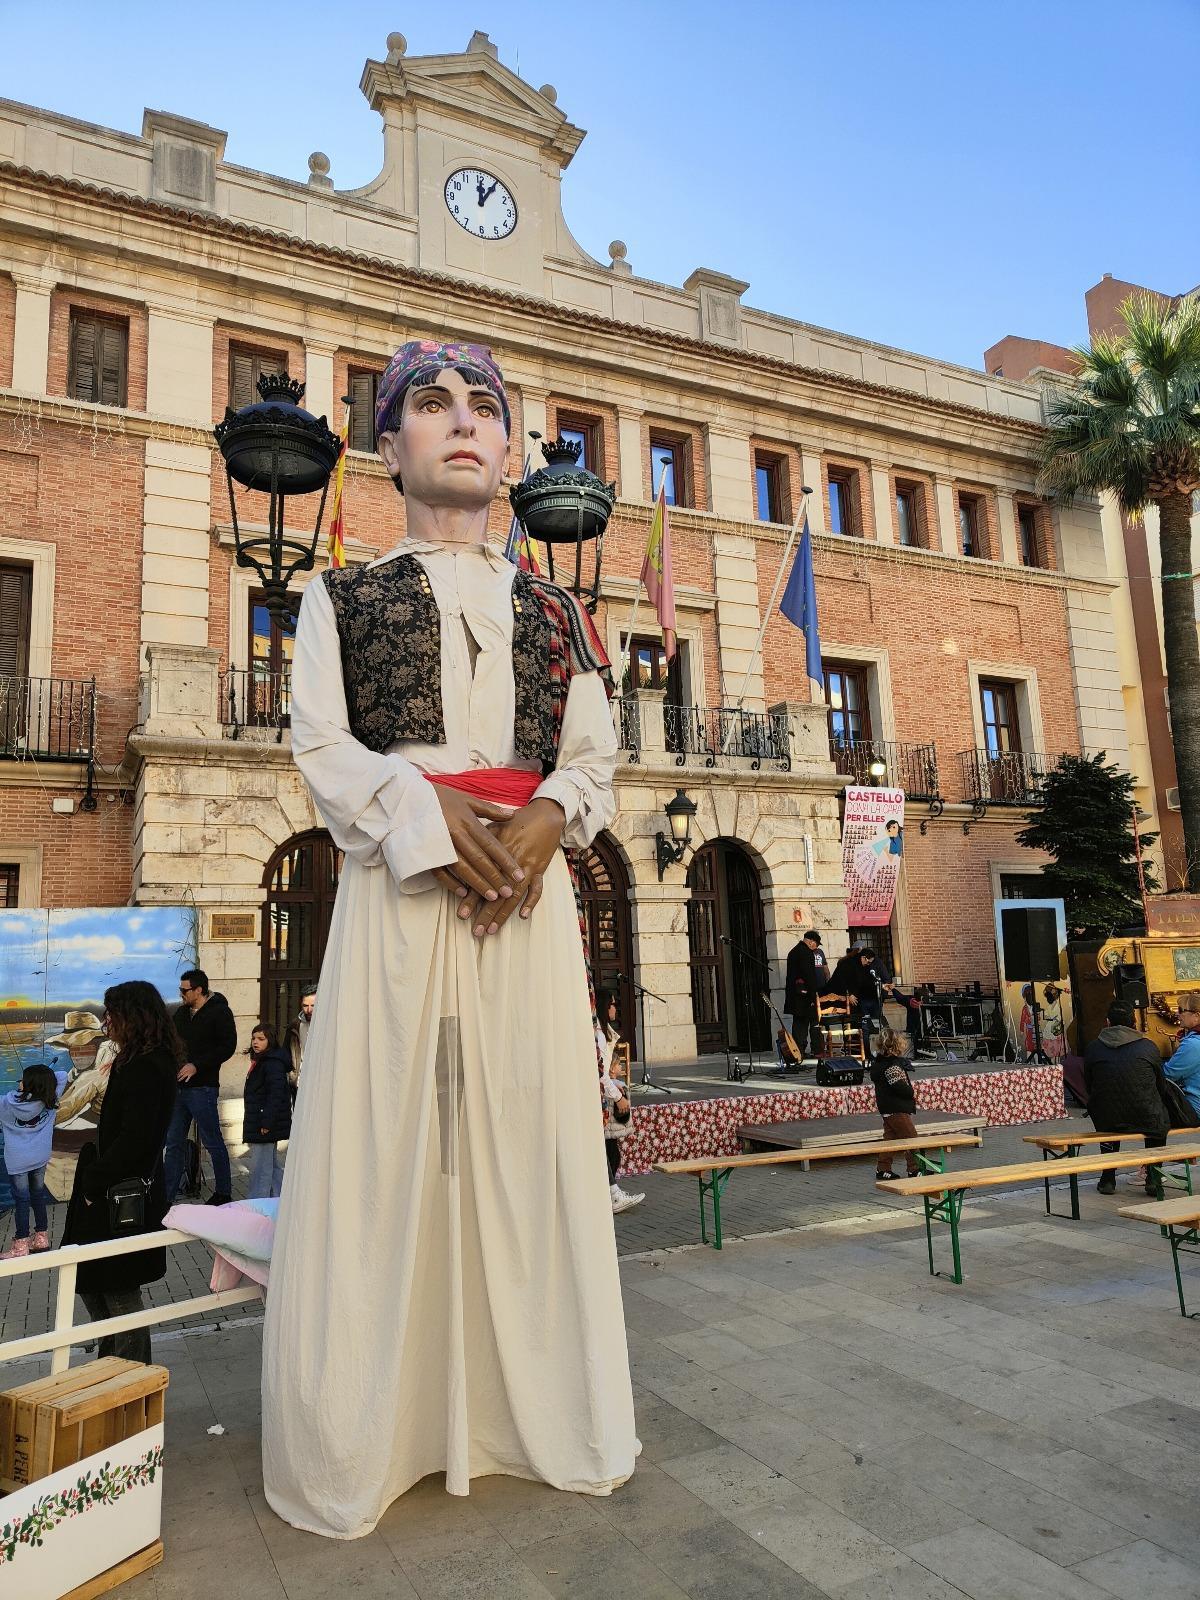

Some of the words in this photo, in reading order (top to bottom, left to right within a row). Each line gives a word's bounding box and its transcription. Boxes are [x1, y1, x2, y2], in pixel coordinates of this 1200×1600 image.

[462, 173, 469, 183] 11
[476, 174, 485, 186] 12
[453, 180, 462, 191] 10
[449, 191, 455, 201] 9
[502, 196, 508, 206] 2
[454, 204, 460, 214] 8
[506, 209, 512, 218] 3
[464, 217, 469, 226] 7
[502, 219, 508, 228] 4
[479, 225, 485, 234] 6
[493, 225, 499, 235] 5
[847, 790, 903, 804] CASTELLÓ
[870, 803, 881, 814] LA
[846, 813, 862, 822] PER
[862, 814, 886, 823] ELLES
